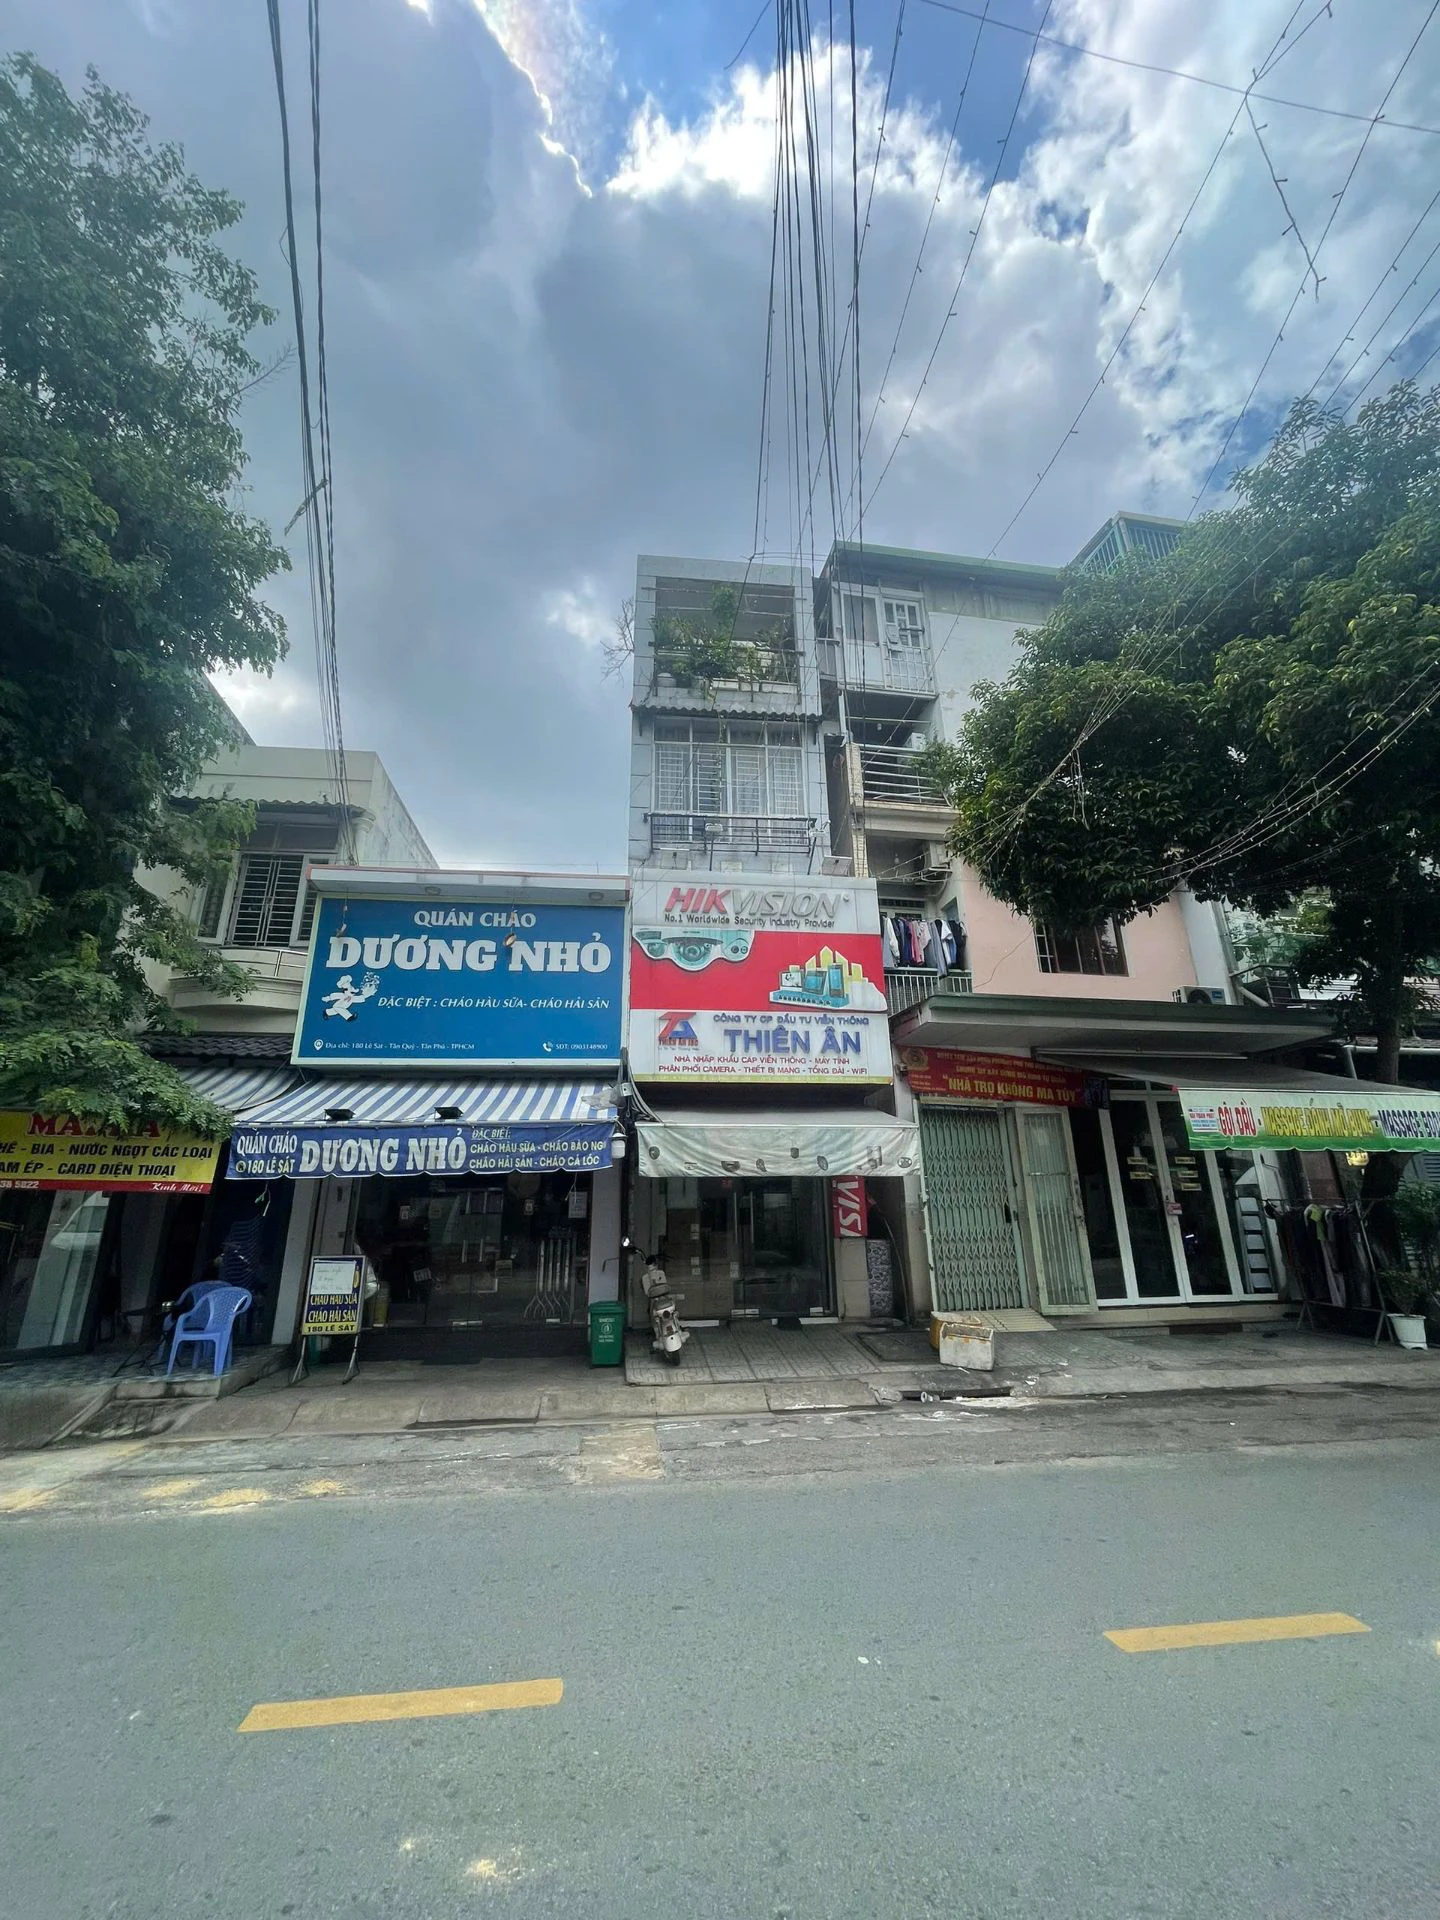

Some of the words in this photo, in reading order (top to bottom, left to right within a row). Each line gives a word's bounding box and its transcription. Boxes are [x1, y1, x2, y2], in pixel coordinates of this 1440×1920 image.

[665, 887, 841, 918] HIKVISION
[414, 908, 473, 928] QUÁN
[480, 908, 536, 928] CHÁO
[665, 914, 682, 922] No.1
[687, 914, 729, 924] Worldwide
[735, 917, 765, 927] Security
[770, 918, 801, 928] Industry
[805, 919, 834, 928] Provider
[326, 934, 497, 971] DƯƠNG
[508, 932, 611, 972] NHỎ
[378, 996, 401, 1008] ĐẶC
[406, 996, 430, 1008] BIỆT
[440, 996, 472, 1008] CHÁO
[476, 997, 500, 1009] HÀU
[531, 997, 562, 1009] CHÁO
[565, 997, 584, 1009] HẢI
[587, 997, 609, 1009] SẢN
[714, 1013, 740, 1023] CÔNG
[744, 1015, 757, 1023] TY
[837, 1015, 869, 1025] THÔNG
[724, 1025, 811, 1053] THIÊN
[821, 1026, 862, 1054] ÂN
[659, 1065, 680, 1073] PHÂN
[780, 1056, 806, 1064] THÔNG
[974, 1080, 994, 1096] TRỌ
[1037, 1086, 1054, 1100] MA
[1261, 1106, 1306, 1137] MASSAGE
[1378, 1110, 1424, 1138] MASSAGE
[31, 1144, 54, 1155] BIA
[69, 1142, 108, 1156] NƯỚC
[112, 1145, 147, 1159] NGỌT
[152, 1144, 178, 1157] CÁC
[182, 1147, 213, 1161] LOẠI
[237, 1132, 267, 1156] QUÁN
[269, 1131, 297, 1153] CHÁO
[298, 1137, 400, 1173] DƯƠNG
[406, 1128, 467, 1171] NHỎ
[470, 1141, 496, 1153] CHÁO
[543, 1140, 568, 1151] CHÁO
[24, 1160, 44, 1174] ÉP
[58, 1162, 95, 1175] CARD
[100, 1162, 134, 1177] ĐIỆN
[138, 1164, 176, 1178] THOẠI
[248, 1160, 264, 1174] 180
[266, 1156, 276, 1173] LÊ
[278, 1156, 295, 1173] SÁT
[470, 1156, 496, 1168] CHÁO
[498, 1155, 512, 1168] HẢI
[515, 1155, 532, 1167] SẢN
[540, 1155, 565, 1166] CHÁO
[568, 1155, 580, 1166] CÁ
[583, 1154, 599, 1165] LÓC
[308, 1308, 328, 1322] CHÁO
